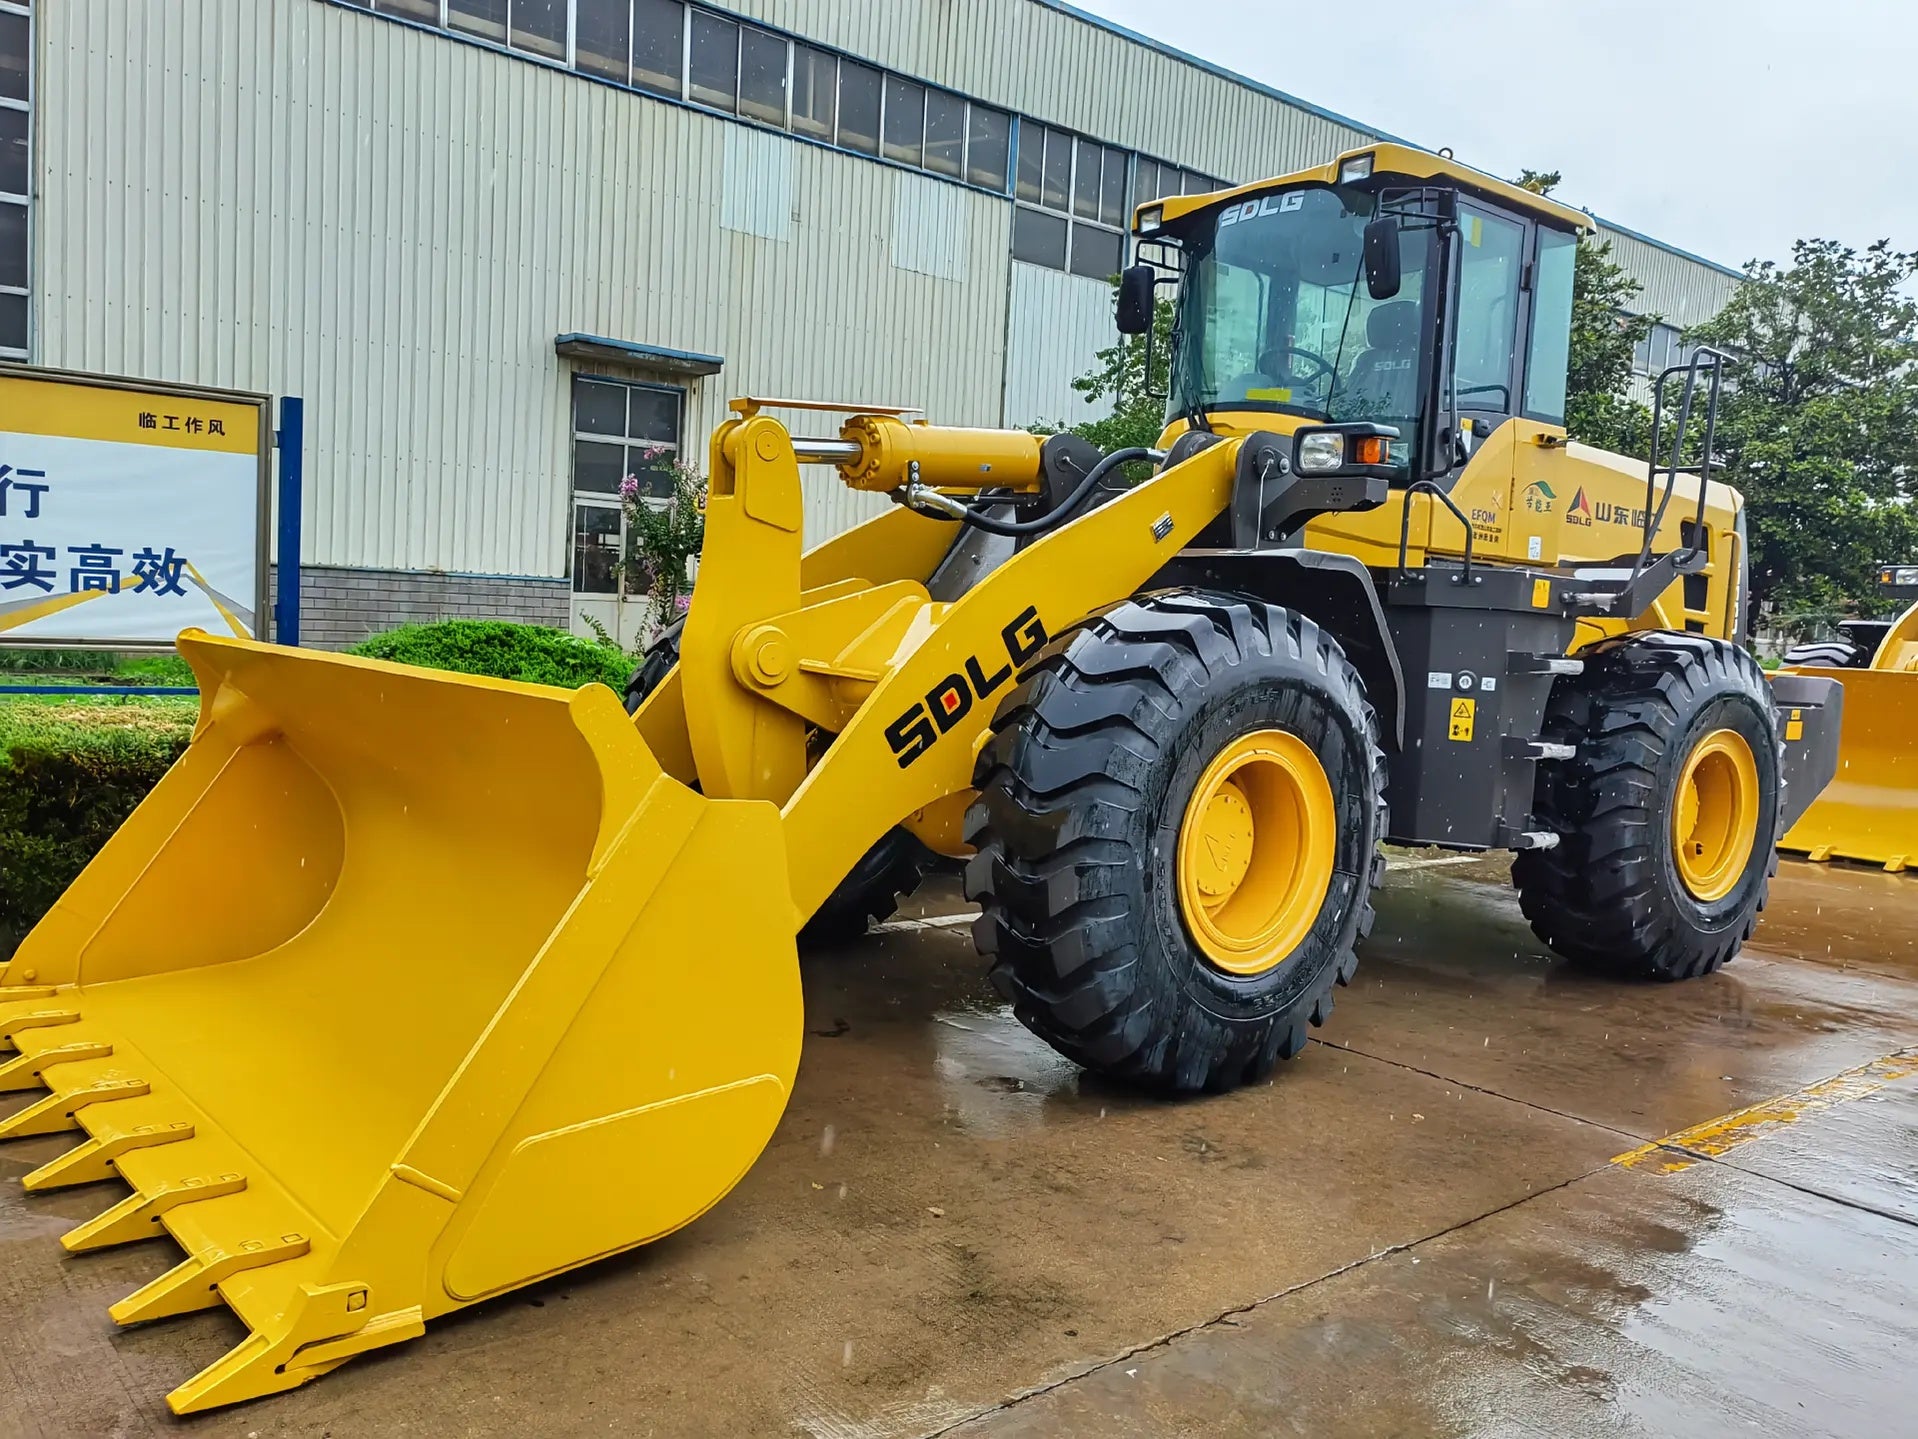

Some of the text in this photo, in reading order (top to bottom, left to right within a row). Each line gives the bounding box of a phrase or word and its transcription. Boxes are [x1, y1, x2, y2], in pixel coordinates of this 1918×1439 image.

[1222, 190, 1305, 227] SDLG
[1373, 358, 1411, 372] SDLG
[138, 412, 226, 436] 临工作风
[0, 465, 49, 519] 行
[1472, 509, 1496, 524] EFQM
[1566, 514, 1593, 527] SDLG
[1, 540, 188, 597] 实高效
[885, 605, 1048, 769] SDLG
